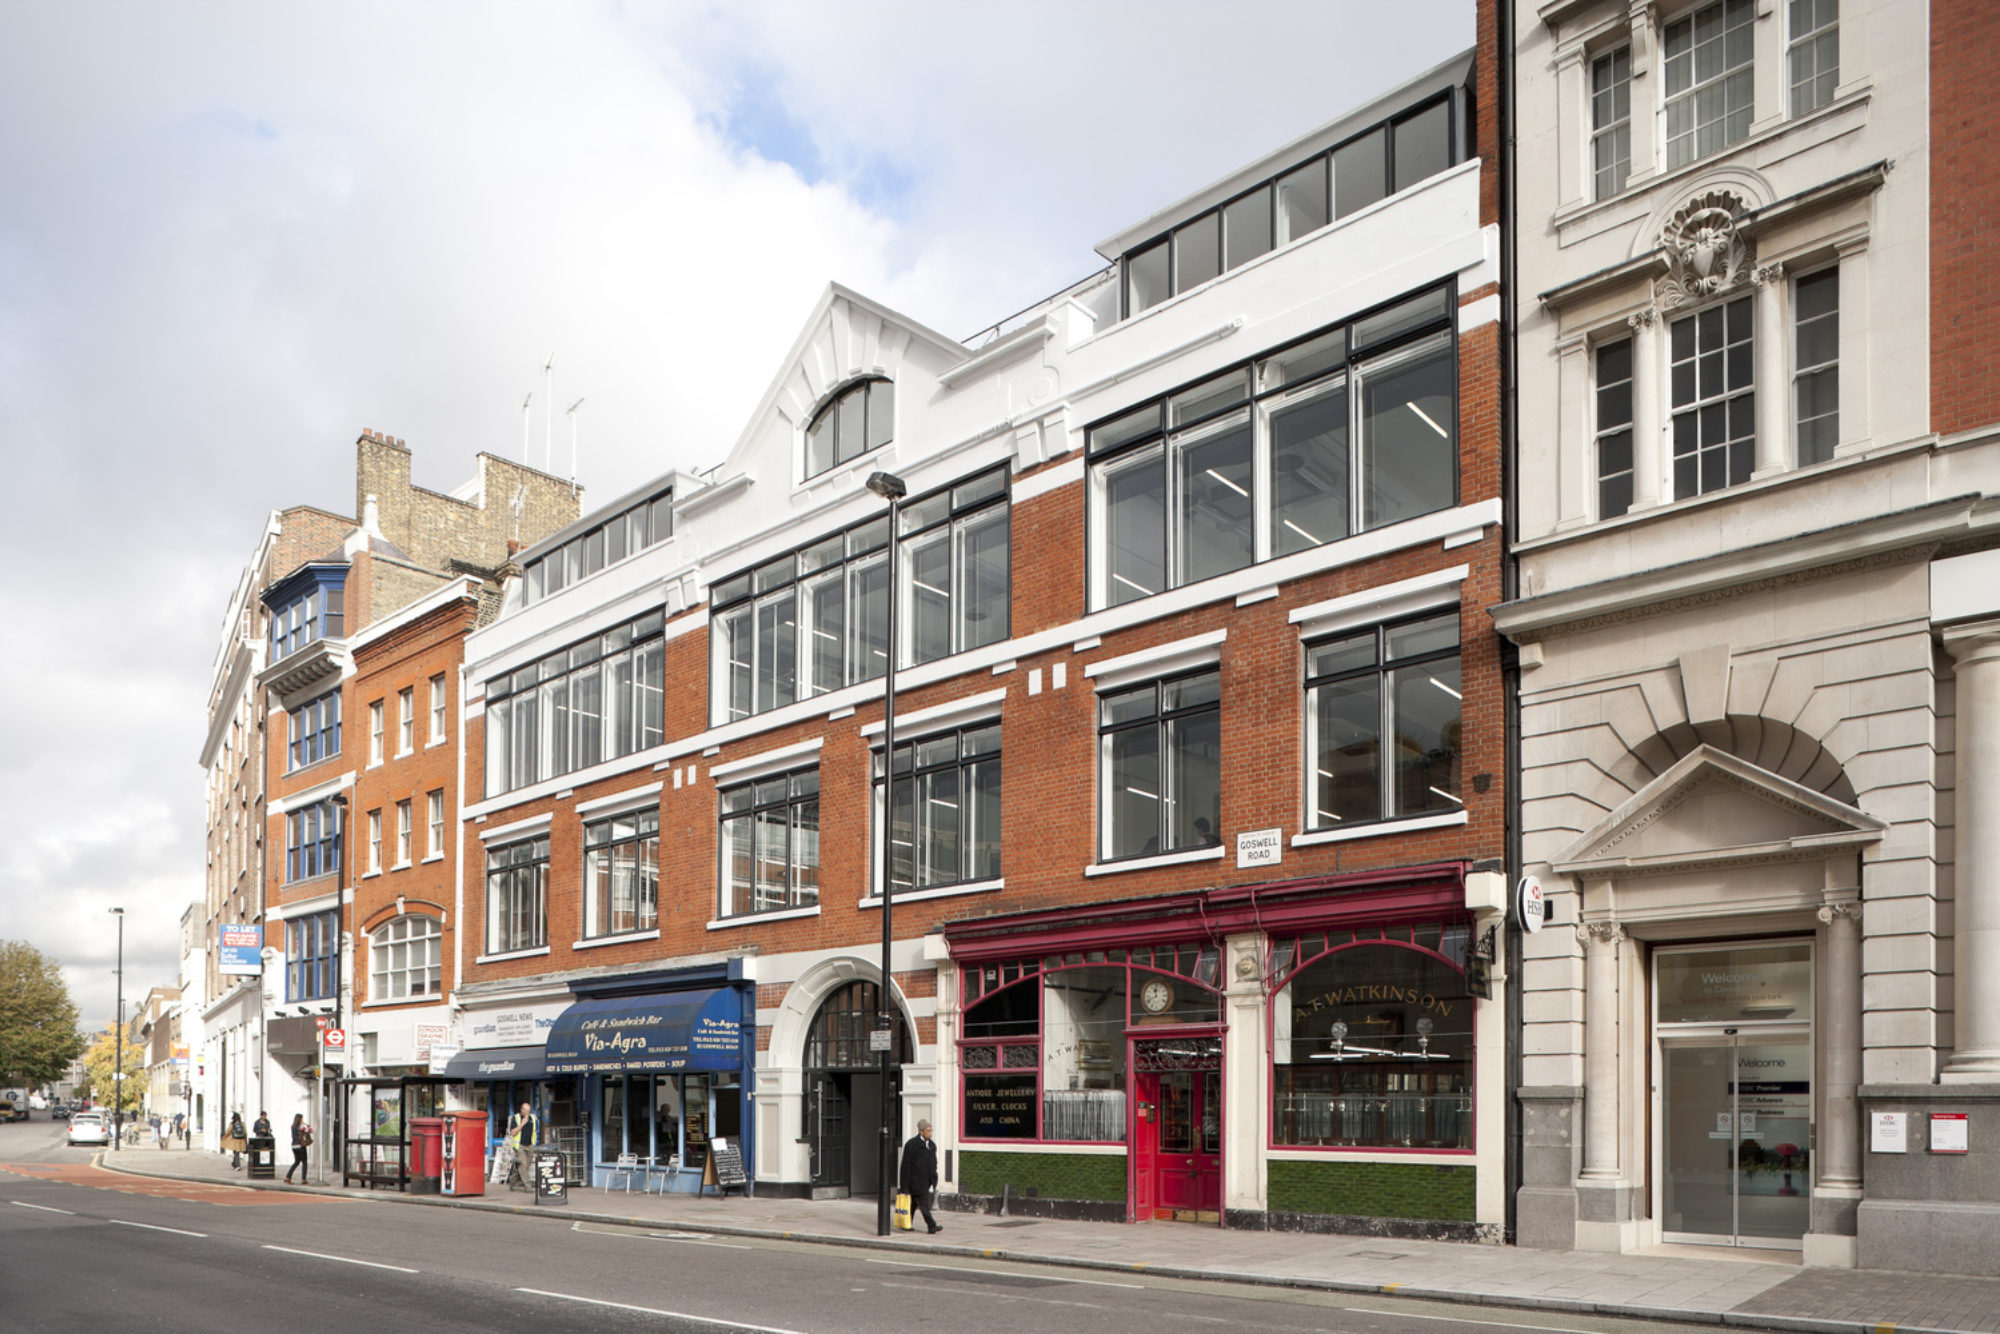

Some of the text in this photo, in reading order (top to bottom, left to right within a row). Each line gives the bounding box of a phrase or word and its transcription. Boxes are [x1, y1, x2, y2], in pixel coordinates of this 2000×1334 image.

[1240, 837, 1278, 850] GOSWELL
[1247, 850, 1270, 860] ROAD
[519, 1012, 532, 1020] NEWS
[609, 1016, 646, 1027] Sandwich
[646, 1014, 662, 1024] Bar
[703, 1018, 739, 1029] Via-Agra
[585, 1031, 646, 1054] Via-Agra
[593, 1062, 622, 1070] SANDWICHES
[671, 1060, 686, 1068] SOUP
[1739, 1058, 1786, 1068] Welcome
[966, 1088, 1034, 1098] ANTIQUE JEWELLERY
[1001, 1102, 1027, 1110] CLOCKS
[979, 1116, 1020, 1124] AND CHINA
